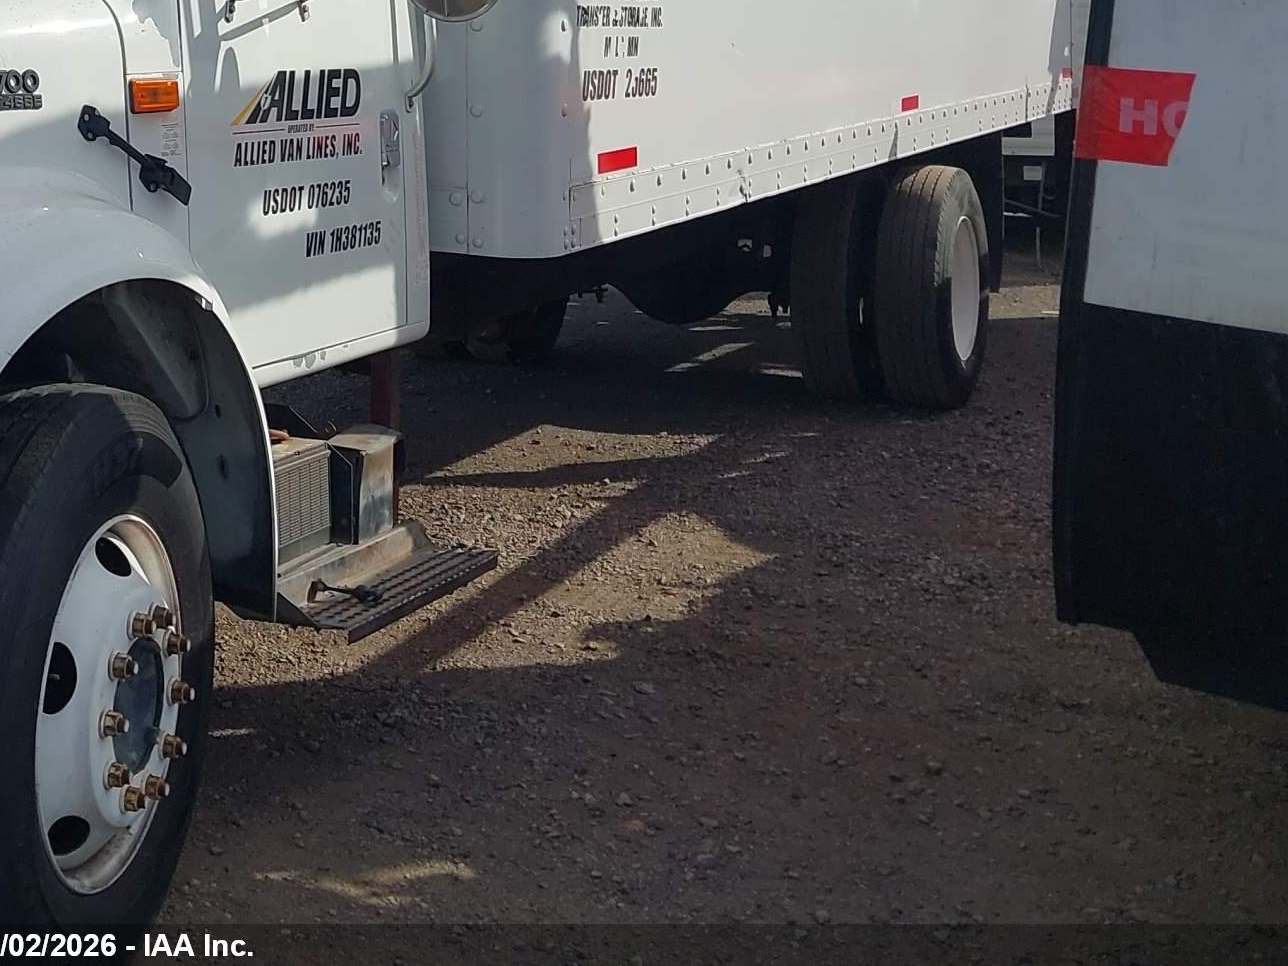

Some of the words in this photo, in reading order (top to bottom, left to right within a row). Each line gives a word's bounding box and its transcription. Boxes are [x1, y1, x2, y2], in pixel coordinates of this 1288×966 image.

[244, 69, 361, 125] ALLIED
[582, 68, 618, 101] USDOT
[233, 140, 276, 167] ALLIED
[280, 136, 303, 163] VAN
[306, 134, 339, 160] LINES,
[342, 132, 362, 157] INC.
[263, 186, 304, 216] USDOT
[307, 180, 351, 209] 076235
[305, 229, 325, 258] VIN
[329, 221, 381, 253] 1H381135
